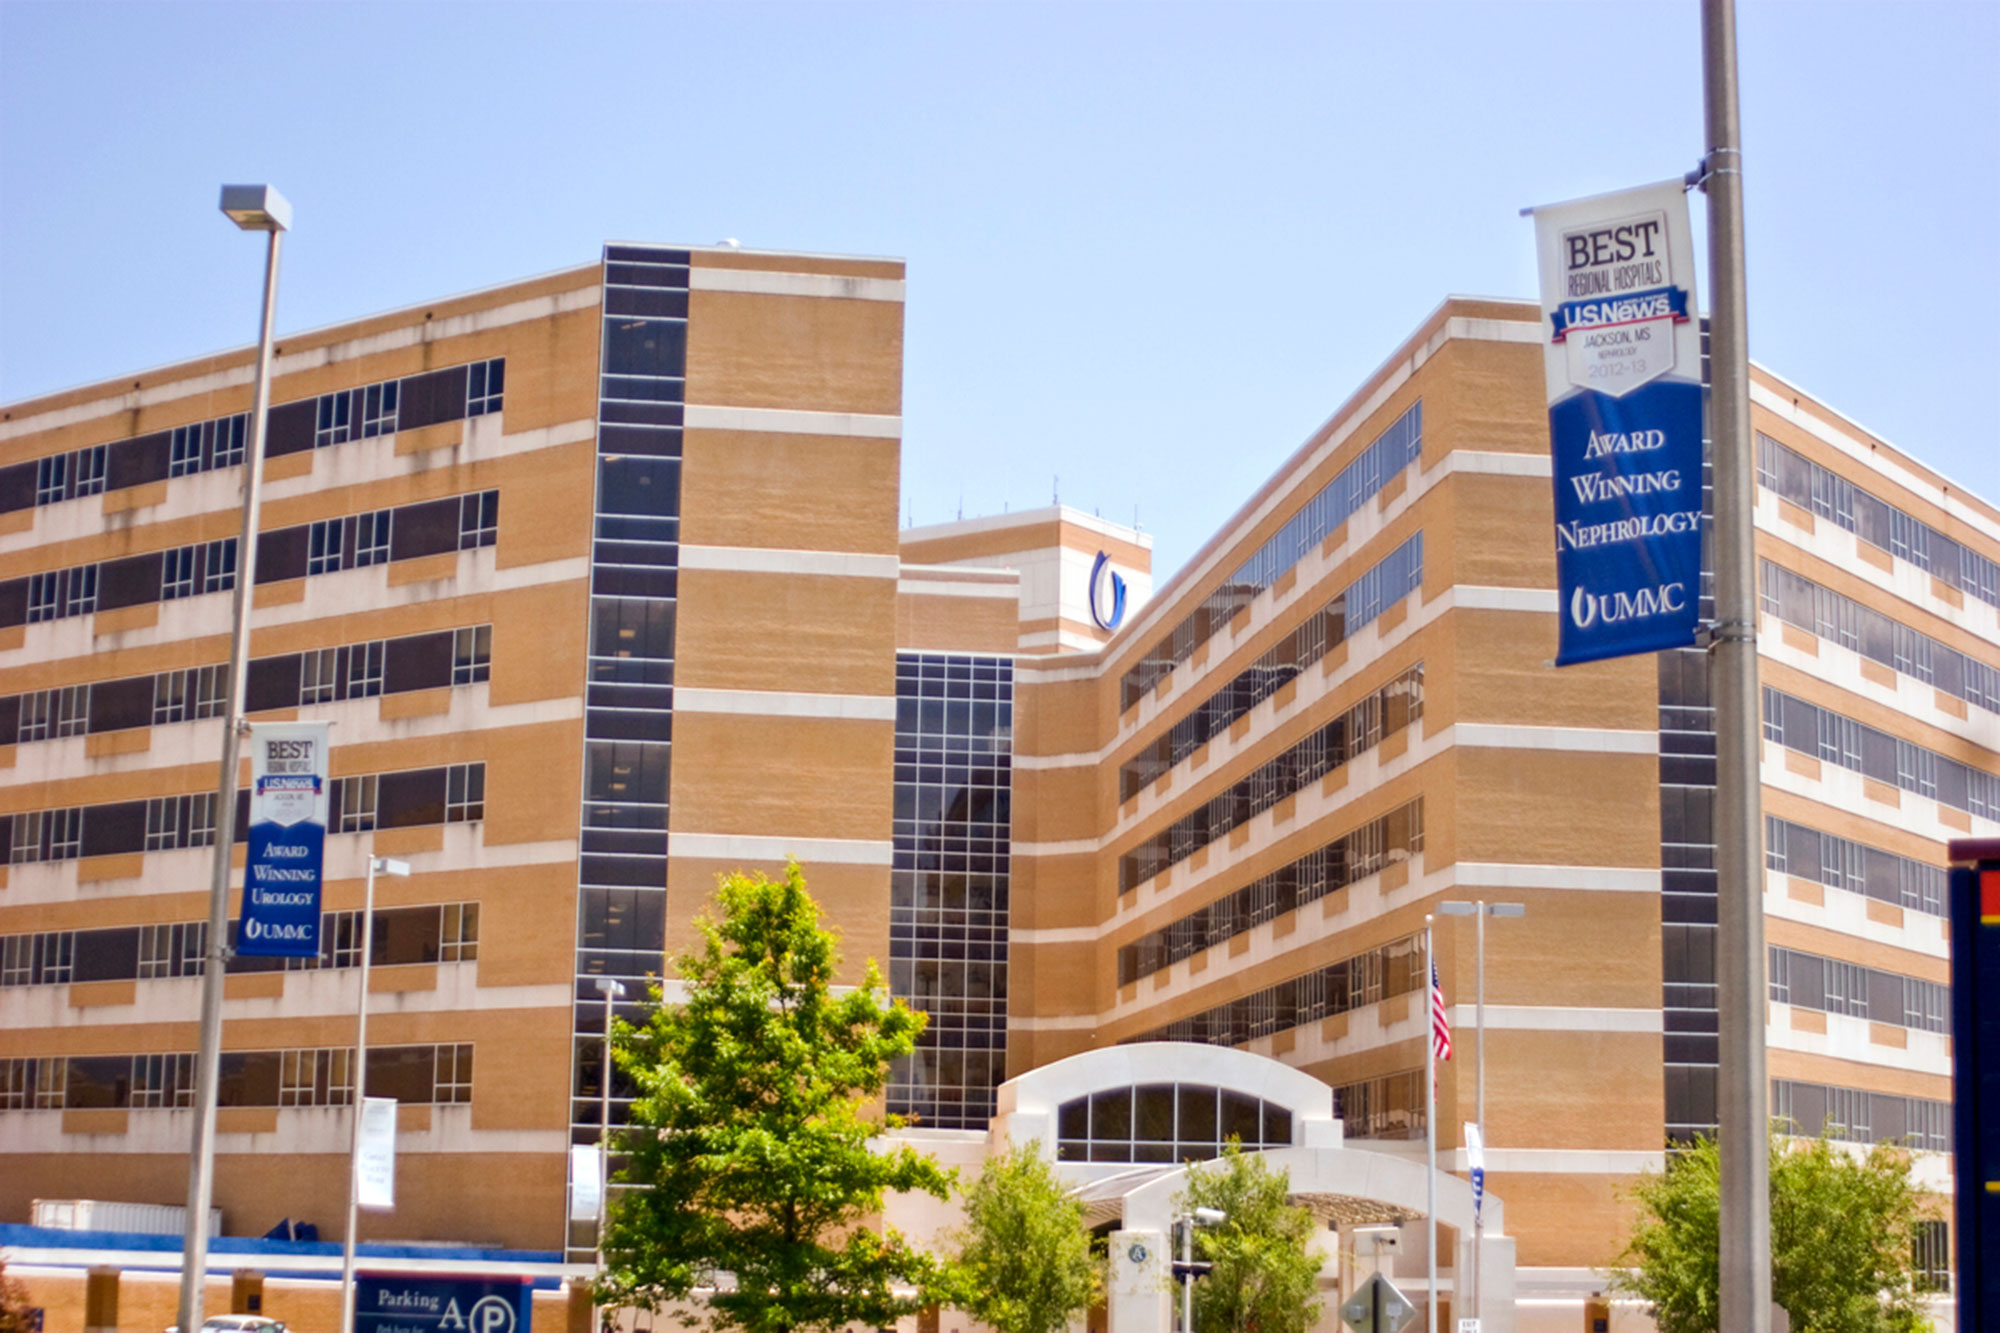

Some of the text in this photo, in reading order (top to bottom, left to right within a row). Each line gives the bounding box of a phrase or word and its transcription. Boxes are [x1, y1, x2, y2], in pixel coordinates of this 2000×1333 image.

[1566, 220, 1659, 271] BEST
[1568, 259, 1662, 297] REGIONAL HOSPITALS
[1634, 327, 1652, 341] MS
[1588, 359, 1647, 378] 2012-13
[1583, 429, 1665, 460] AWARD
[1571, 470, 1681, 504] WINNING
[1556, 510, 1702, 551] NEPHROLOGY
[1600, 582, 1685, 622] UMMC
[266, 740, 313, 759] BEST
[262, 841, 309, 858] AWARD
[252, 864, 316, 881] WINNING
[251, 887, 314, 905] UROLOGY
[263, 923, 313, 940] UMMC
[377, 1289, 466, 1329] Parking A
[483, 1305, 506, 1333] P
